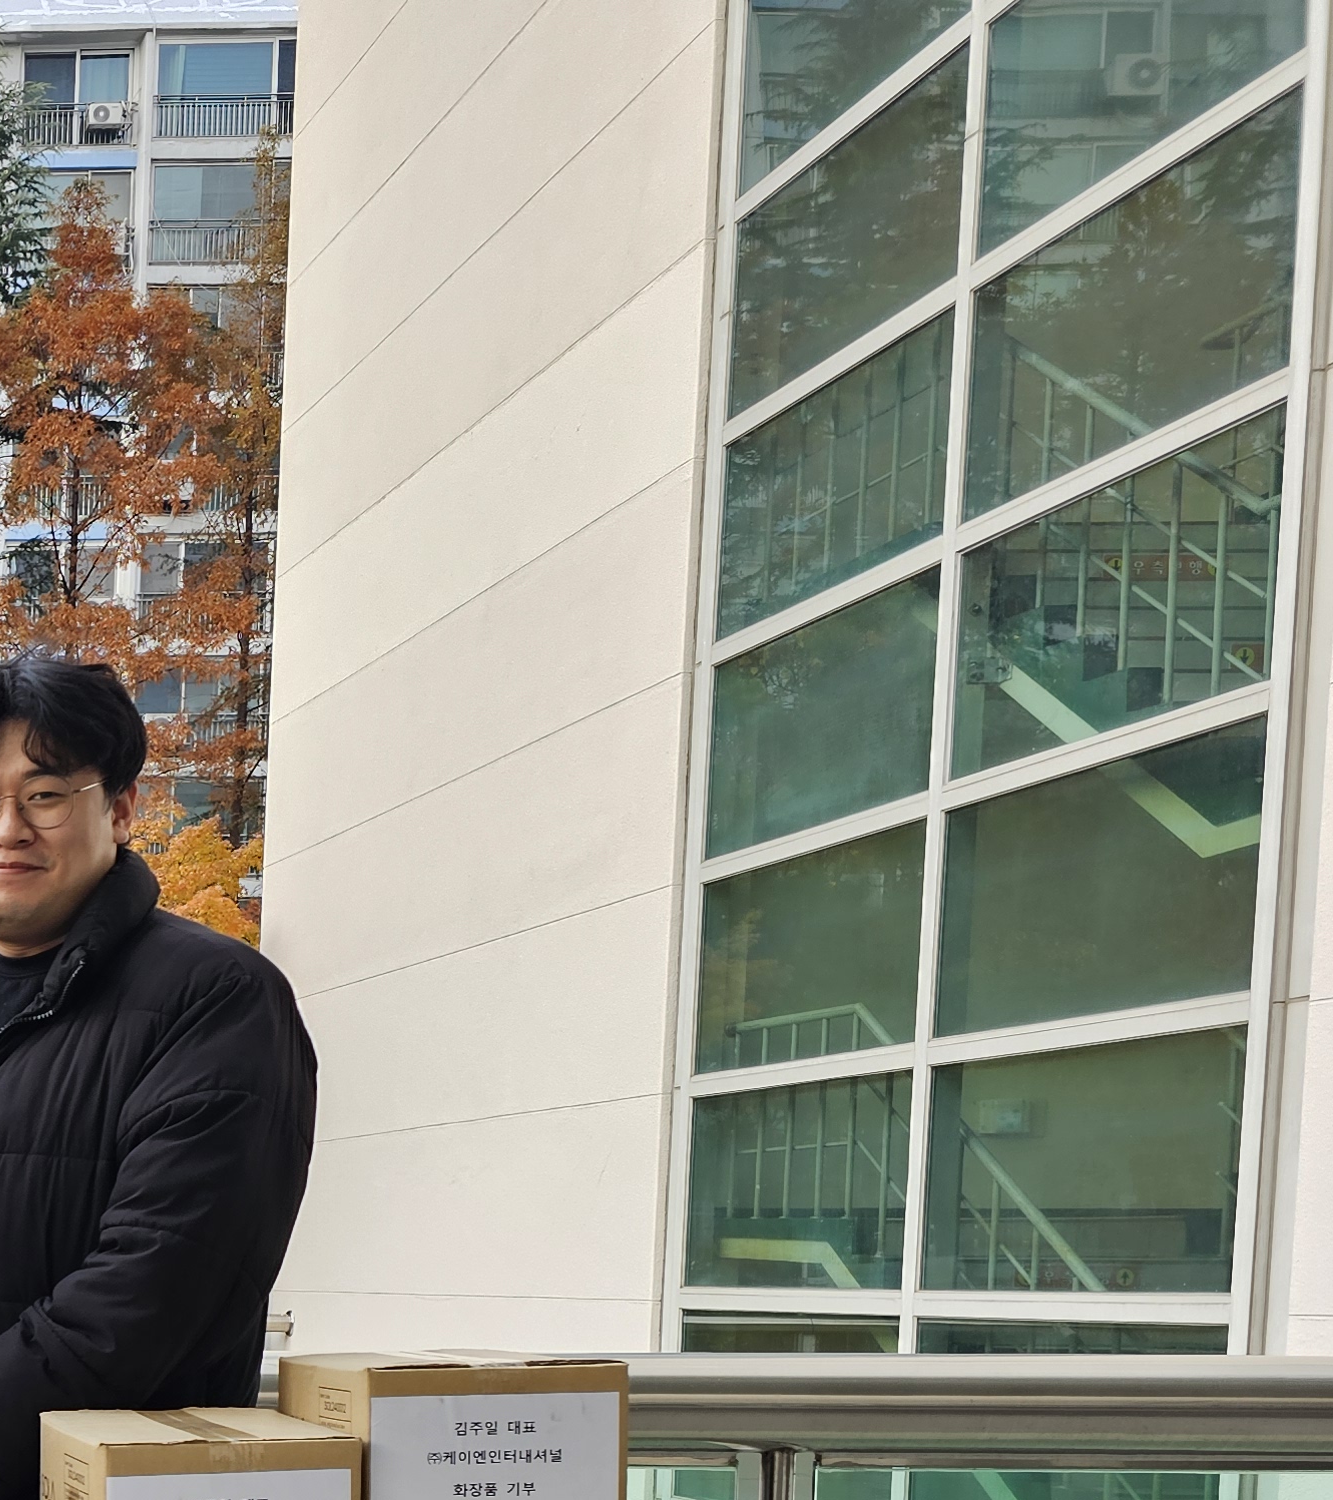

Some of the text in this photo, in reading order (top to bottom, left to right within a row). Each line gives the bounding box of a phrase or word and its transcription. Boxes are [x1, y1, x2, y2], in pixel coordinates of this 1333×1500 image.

[455, 1421, 536, 1436] 김주일 대표
[453, 1482, 536, 1497] 화장품 기부
